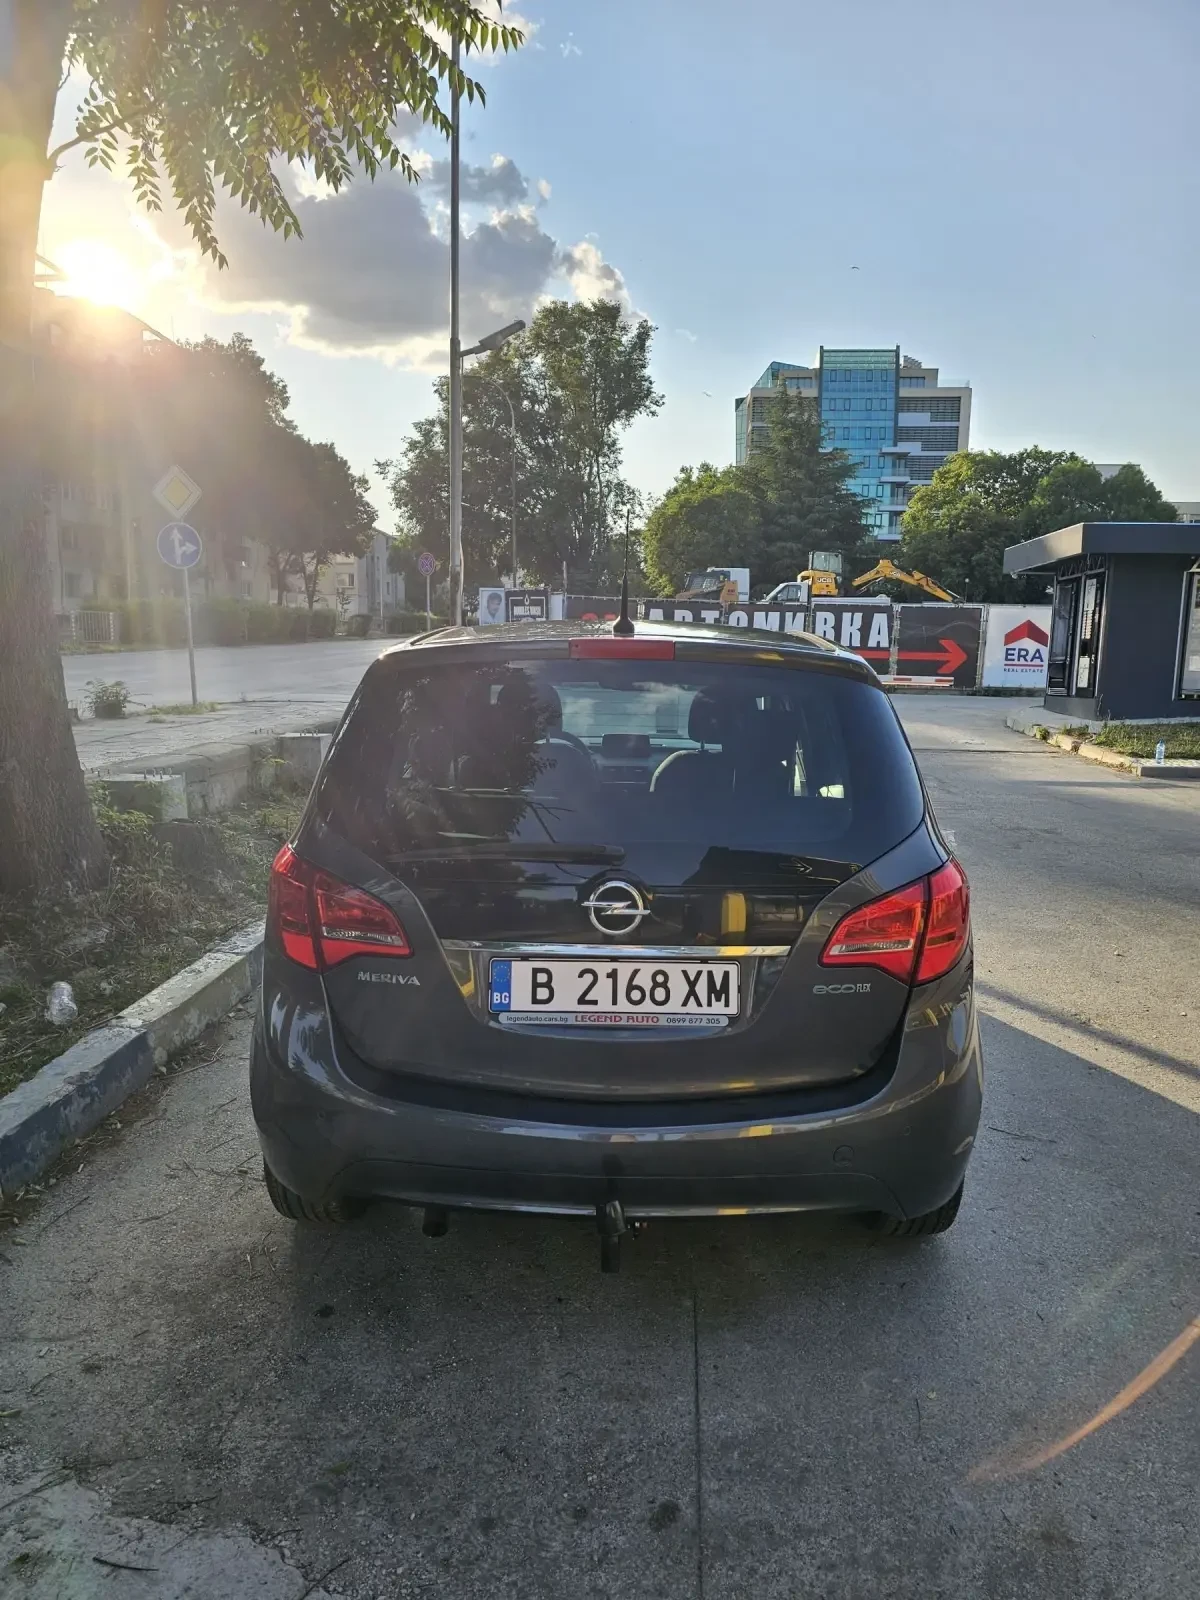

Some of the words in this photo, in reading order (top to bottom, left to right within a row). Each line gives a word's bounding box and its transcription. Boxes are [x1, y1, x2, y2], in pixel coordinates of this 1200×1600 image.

[1004, 648, 1044, 662] ERA
[357, 971, 421, 986] MERIVA
[531, 967, 554, 1005] B
[577, 968, 671, 1006] 2168
[680, 969, 730, 1008] XM
[493, 992, 510, 1004] BG
[506, 1015, 569, 1023] legendauto.cars.bg
[574, 1014, 623, 1023] LEGEND
[626, 1015, 660, 1024] AUTO
[688, 1017, 703, 1025] 877
[705, 1017, 721, 1025] 305
